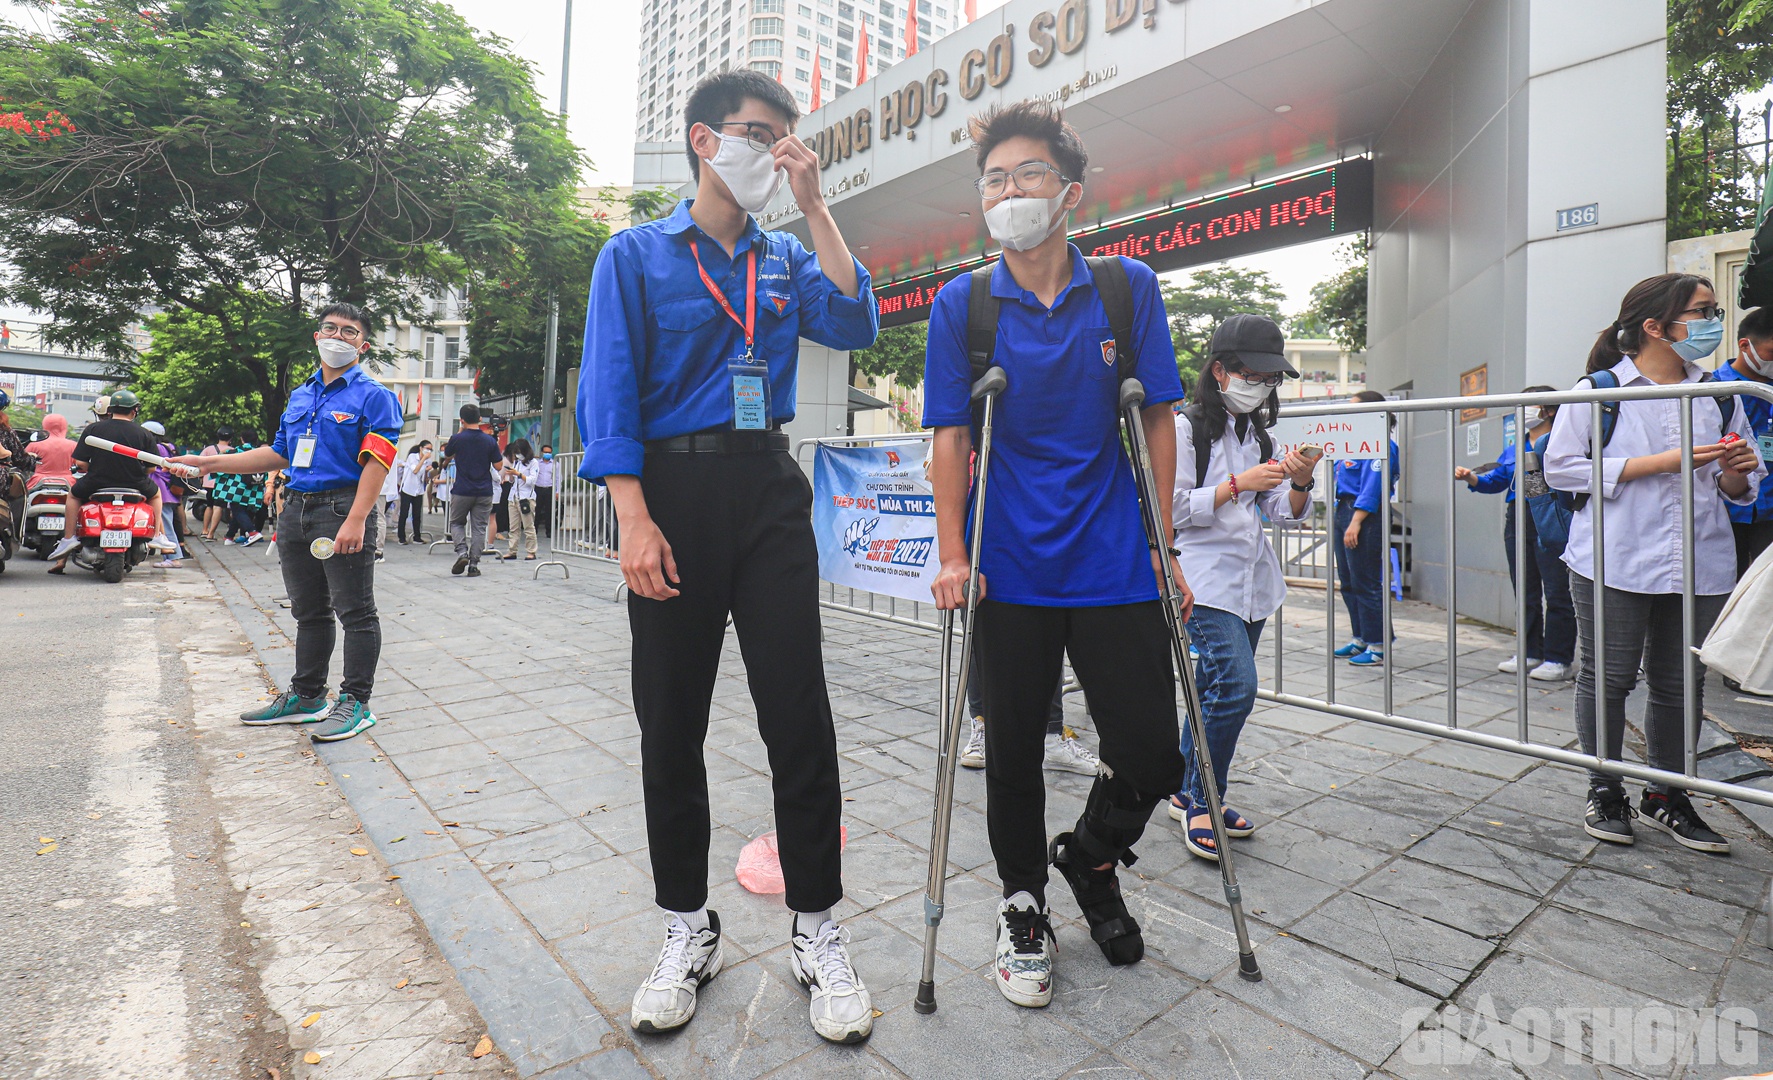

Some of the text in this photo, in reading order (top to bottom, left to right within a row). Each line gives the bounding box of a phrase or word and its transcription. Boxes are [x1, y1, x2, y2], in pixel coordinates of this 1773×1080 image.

[879, 68, 949, 141] HỌC
[959, 23, 1015, 101] CƠ
[1560, 207, 1595, 227] 186
[904, 286, 923, 309] VÀ
[1154, 221, 1202, 252] CÁC
[1206, 207, 1263, 241] CON
[1269, 190, 1335, 227] HỌC
[866, 482, 914, 492] CHƯƠNG TRÌNH
[832, 493, 855, 509] TIẾP
[856, 495, 877, 510] SỨC
[880, 496, 903, 512] MÙA
[904, 500, 923, 513] THI
[870, 539, 885, 551] TIẾP
[892, 540, 931, 565] 2022
[873, 565, 887, 573] CHÚNG
[899, 568, 910, 577] CÙNG
